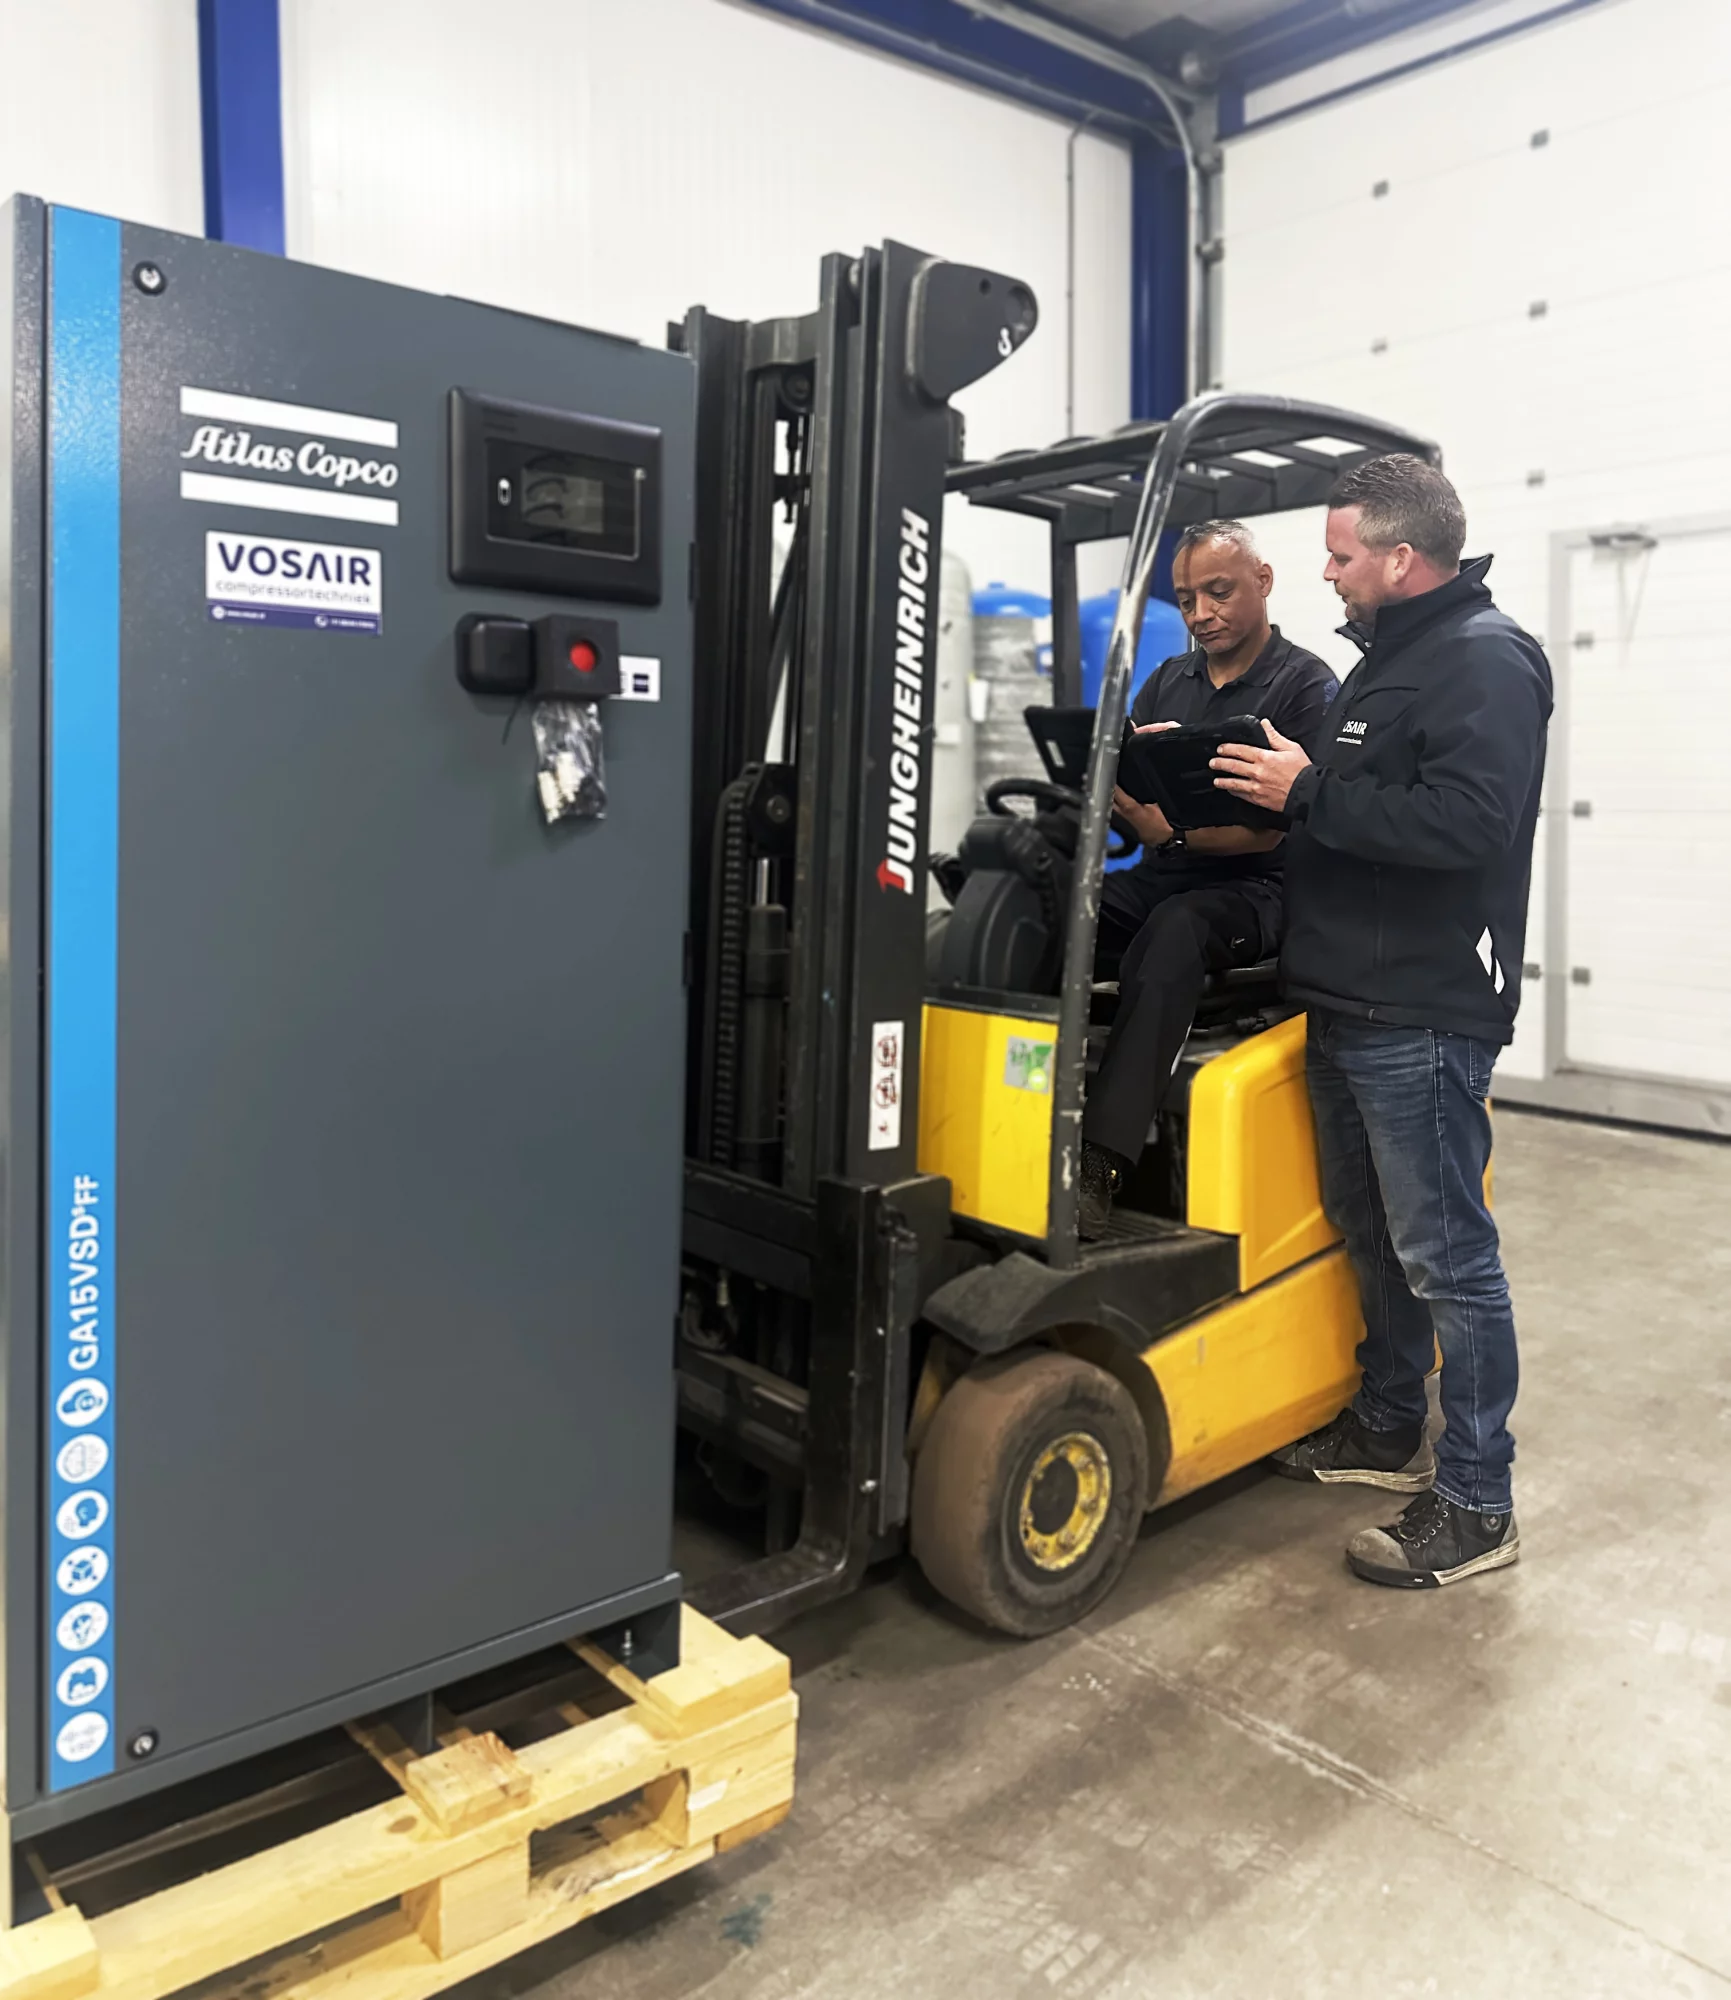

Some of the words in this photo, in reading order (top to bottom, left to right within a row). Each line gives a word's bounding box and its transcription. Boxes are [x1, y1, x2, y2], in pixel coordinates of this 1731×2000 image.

[180, 425, 294, 472] Atlas
[297, 441, 398, 488] Copco
[217, 541, 371, 587] VOSAIR
[877, 506, 930, 896] JUNGHEINRICH
[1342, 720, 1368, 735] OSAIR
